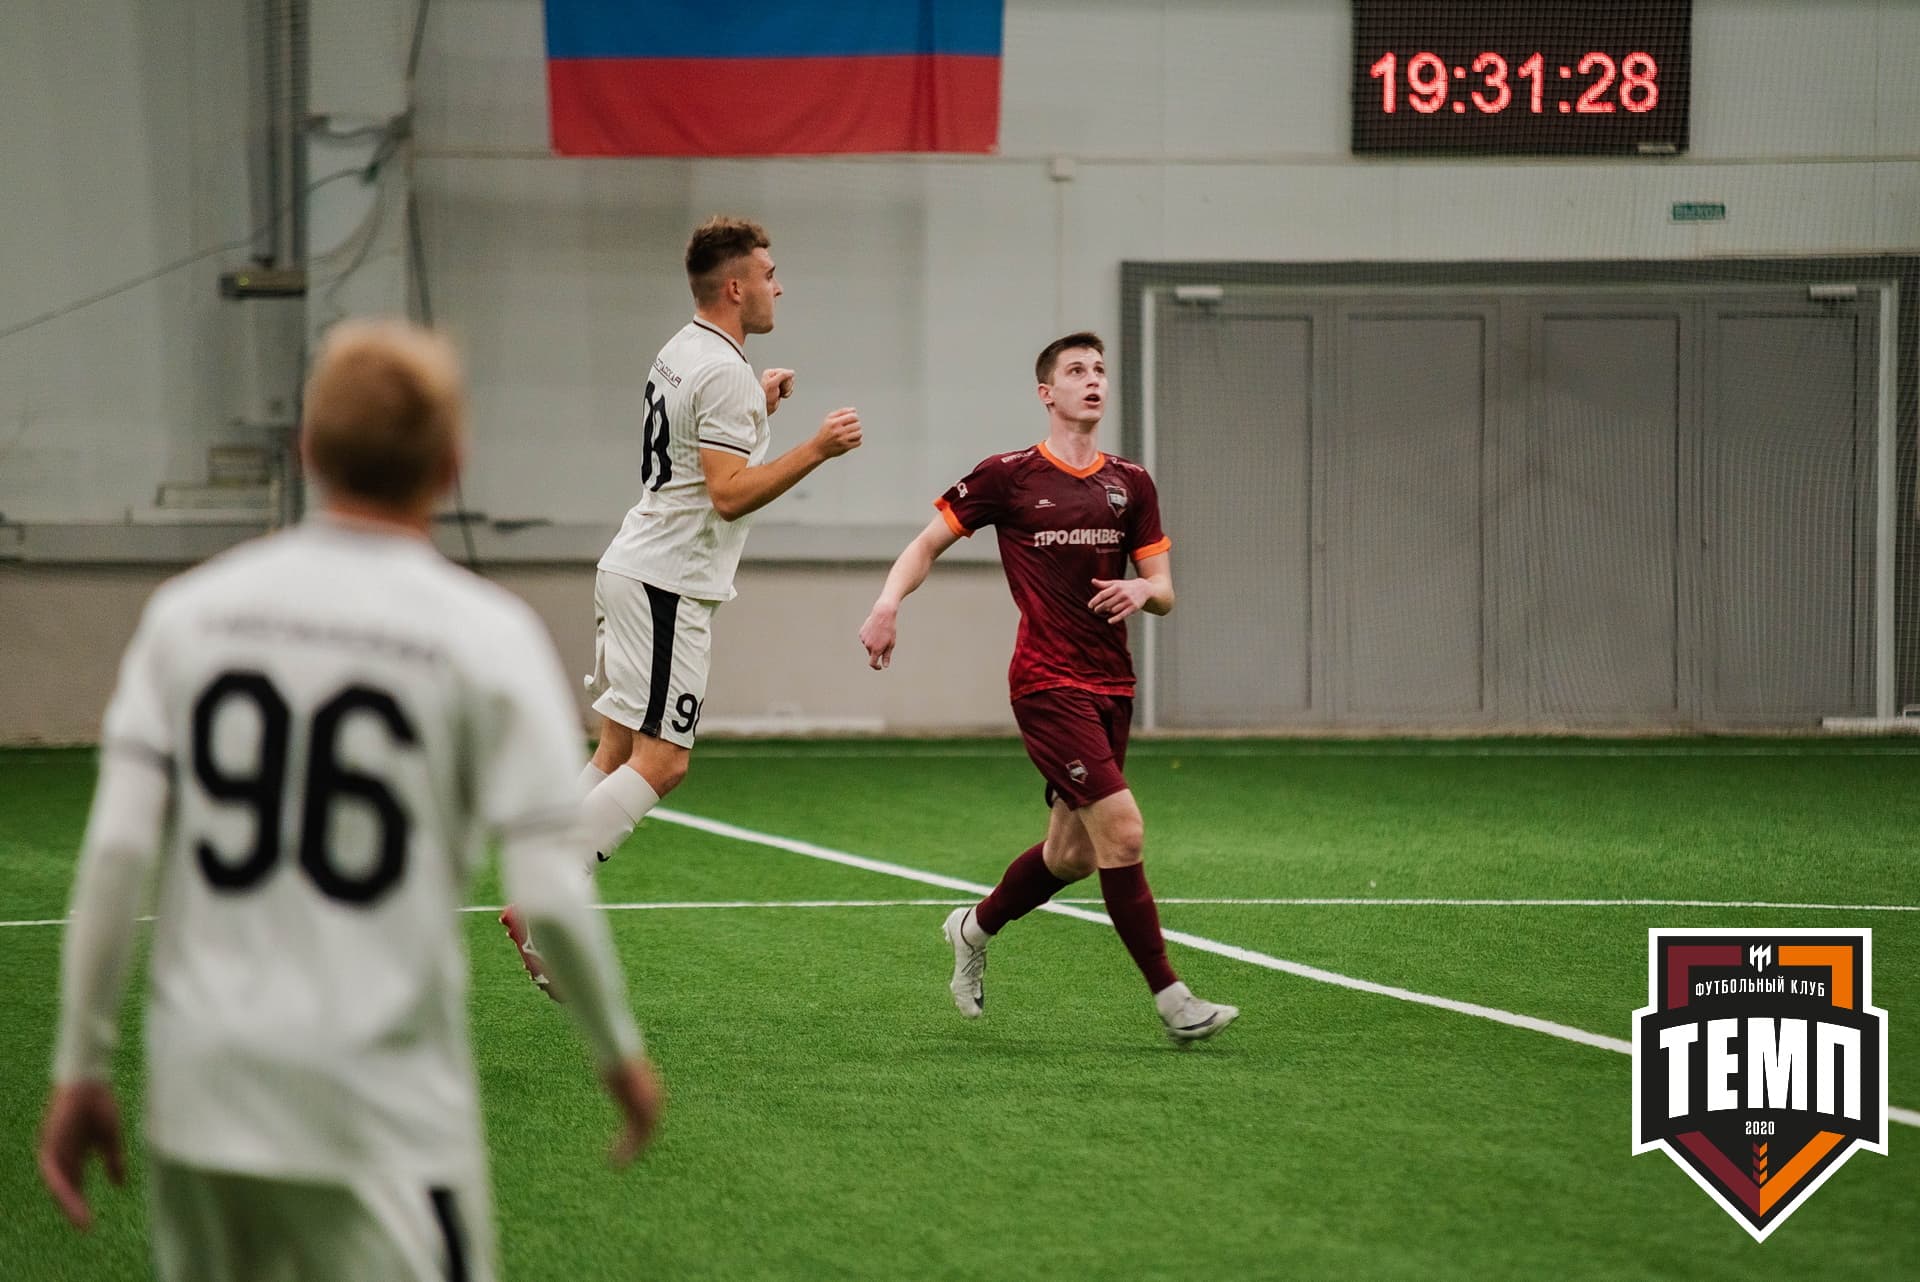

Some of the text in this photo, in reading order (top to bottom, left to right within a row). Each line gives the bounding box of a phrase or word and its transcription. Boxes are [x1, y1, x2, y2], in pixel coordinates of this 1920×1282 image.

[1370, 51, 1659, 113] 19:31:28
[671, 692, 704, 738] 9
[190, 670, 423, 911] 96
